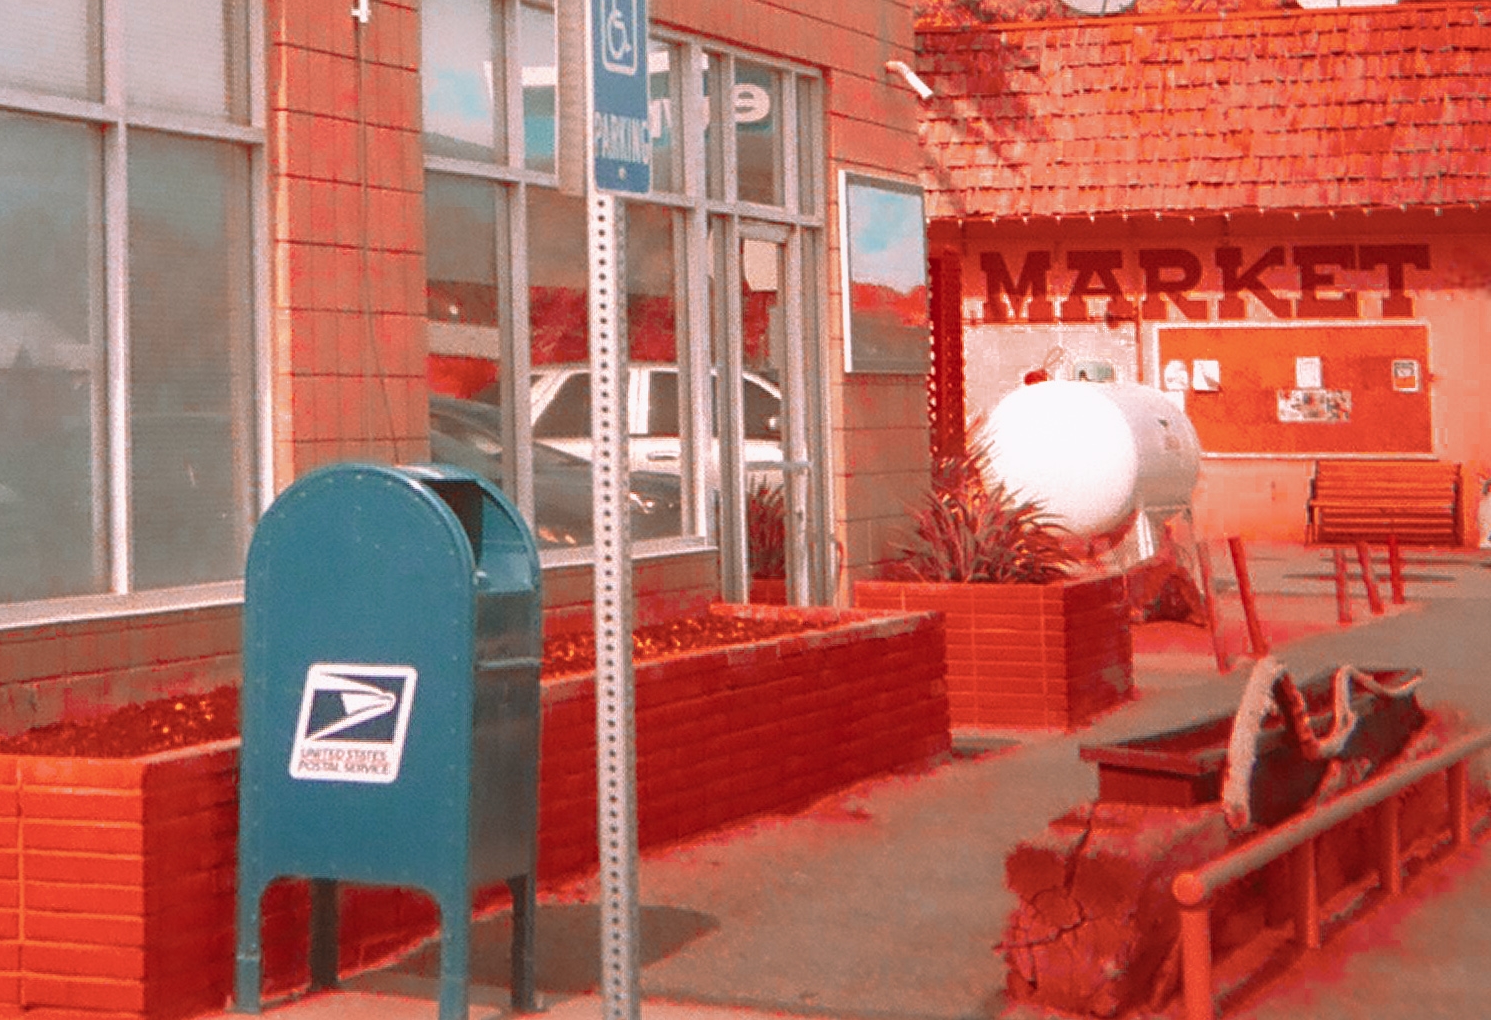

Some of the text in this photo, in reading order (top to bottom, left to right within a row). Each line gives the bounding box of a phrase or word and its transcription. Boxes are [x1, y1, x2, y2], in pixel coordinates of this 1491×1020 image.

[594, 111, 651, 165] PARKING
[980, 244, 1430, 320] MARKET
[298, 760, 389, 775] POSTAL SERVICE
[301, 749, 388, 761] UNITED STATES
